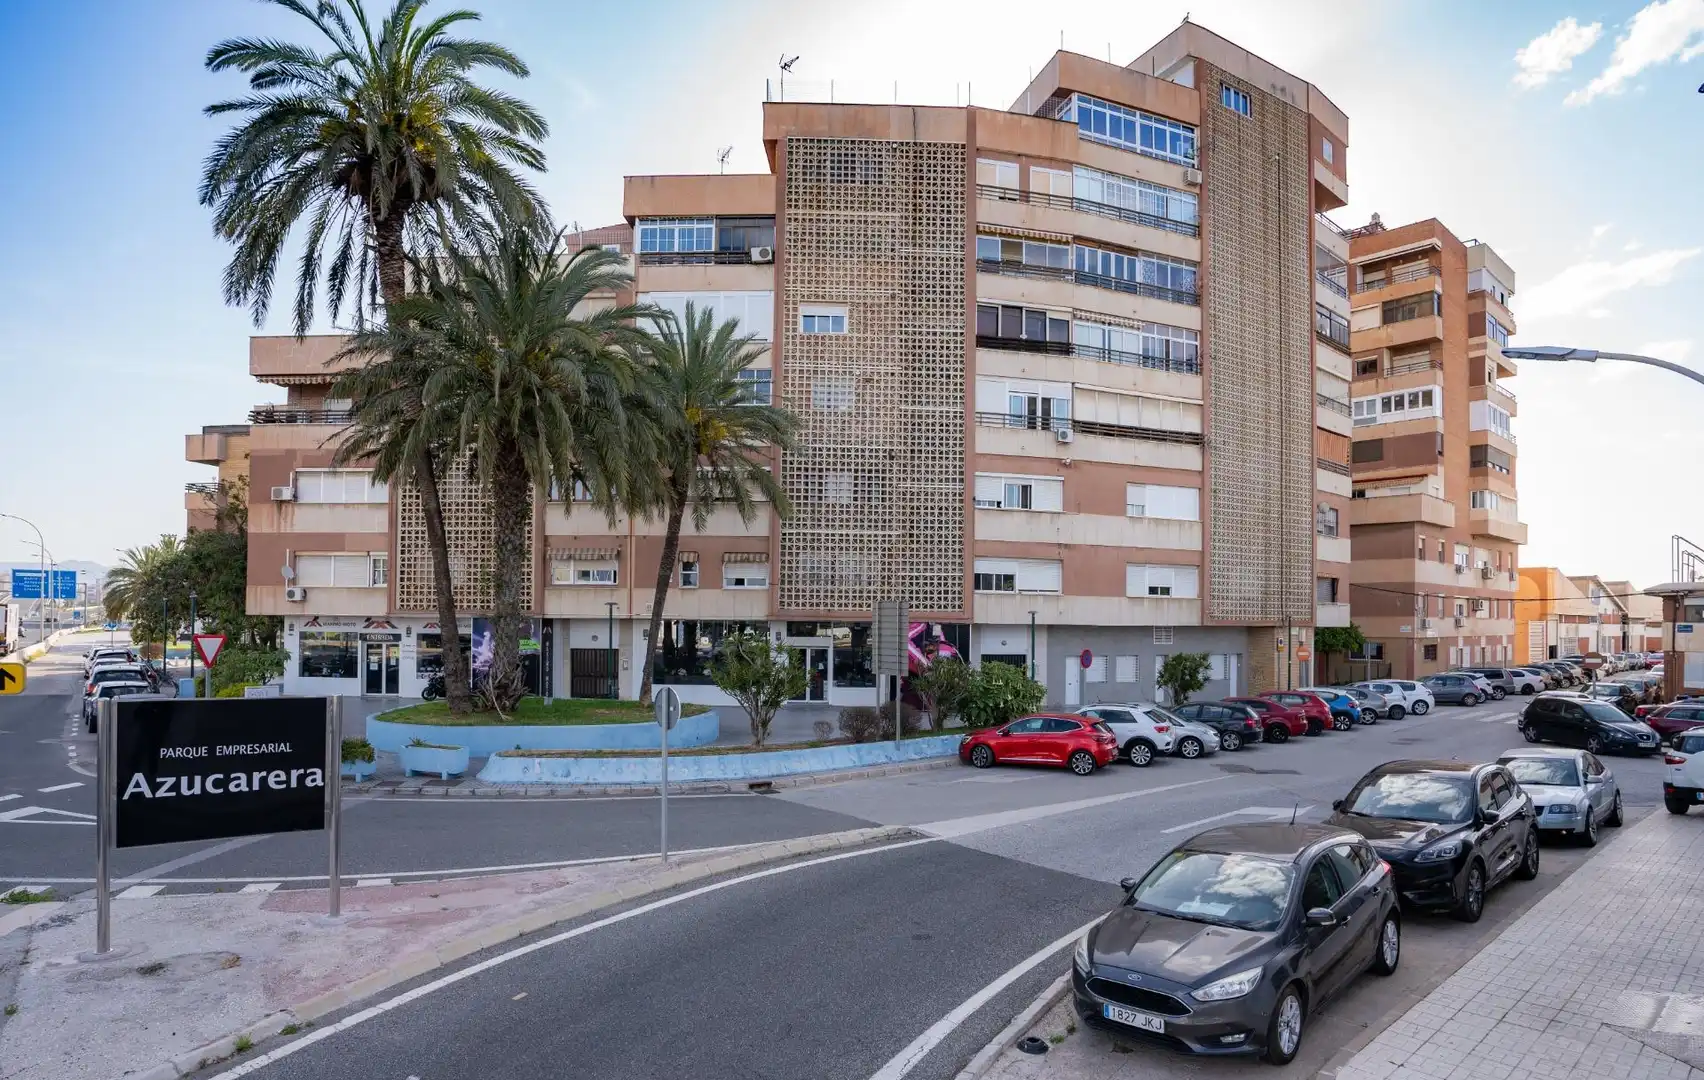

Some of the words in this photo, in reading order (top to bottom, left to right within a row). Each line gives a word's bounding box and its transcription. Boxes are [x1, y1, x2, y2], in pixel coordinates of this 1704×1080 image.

[160, 746, 208, 759] PARQUE
[216, 742, 293, 756] EMPRESARIAL
[122, 767, 324, 800] Azucarera
[1112, 1007, 1137, 1024] 1827
[1141, 1016, 1162, 1030] JKJ
